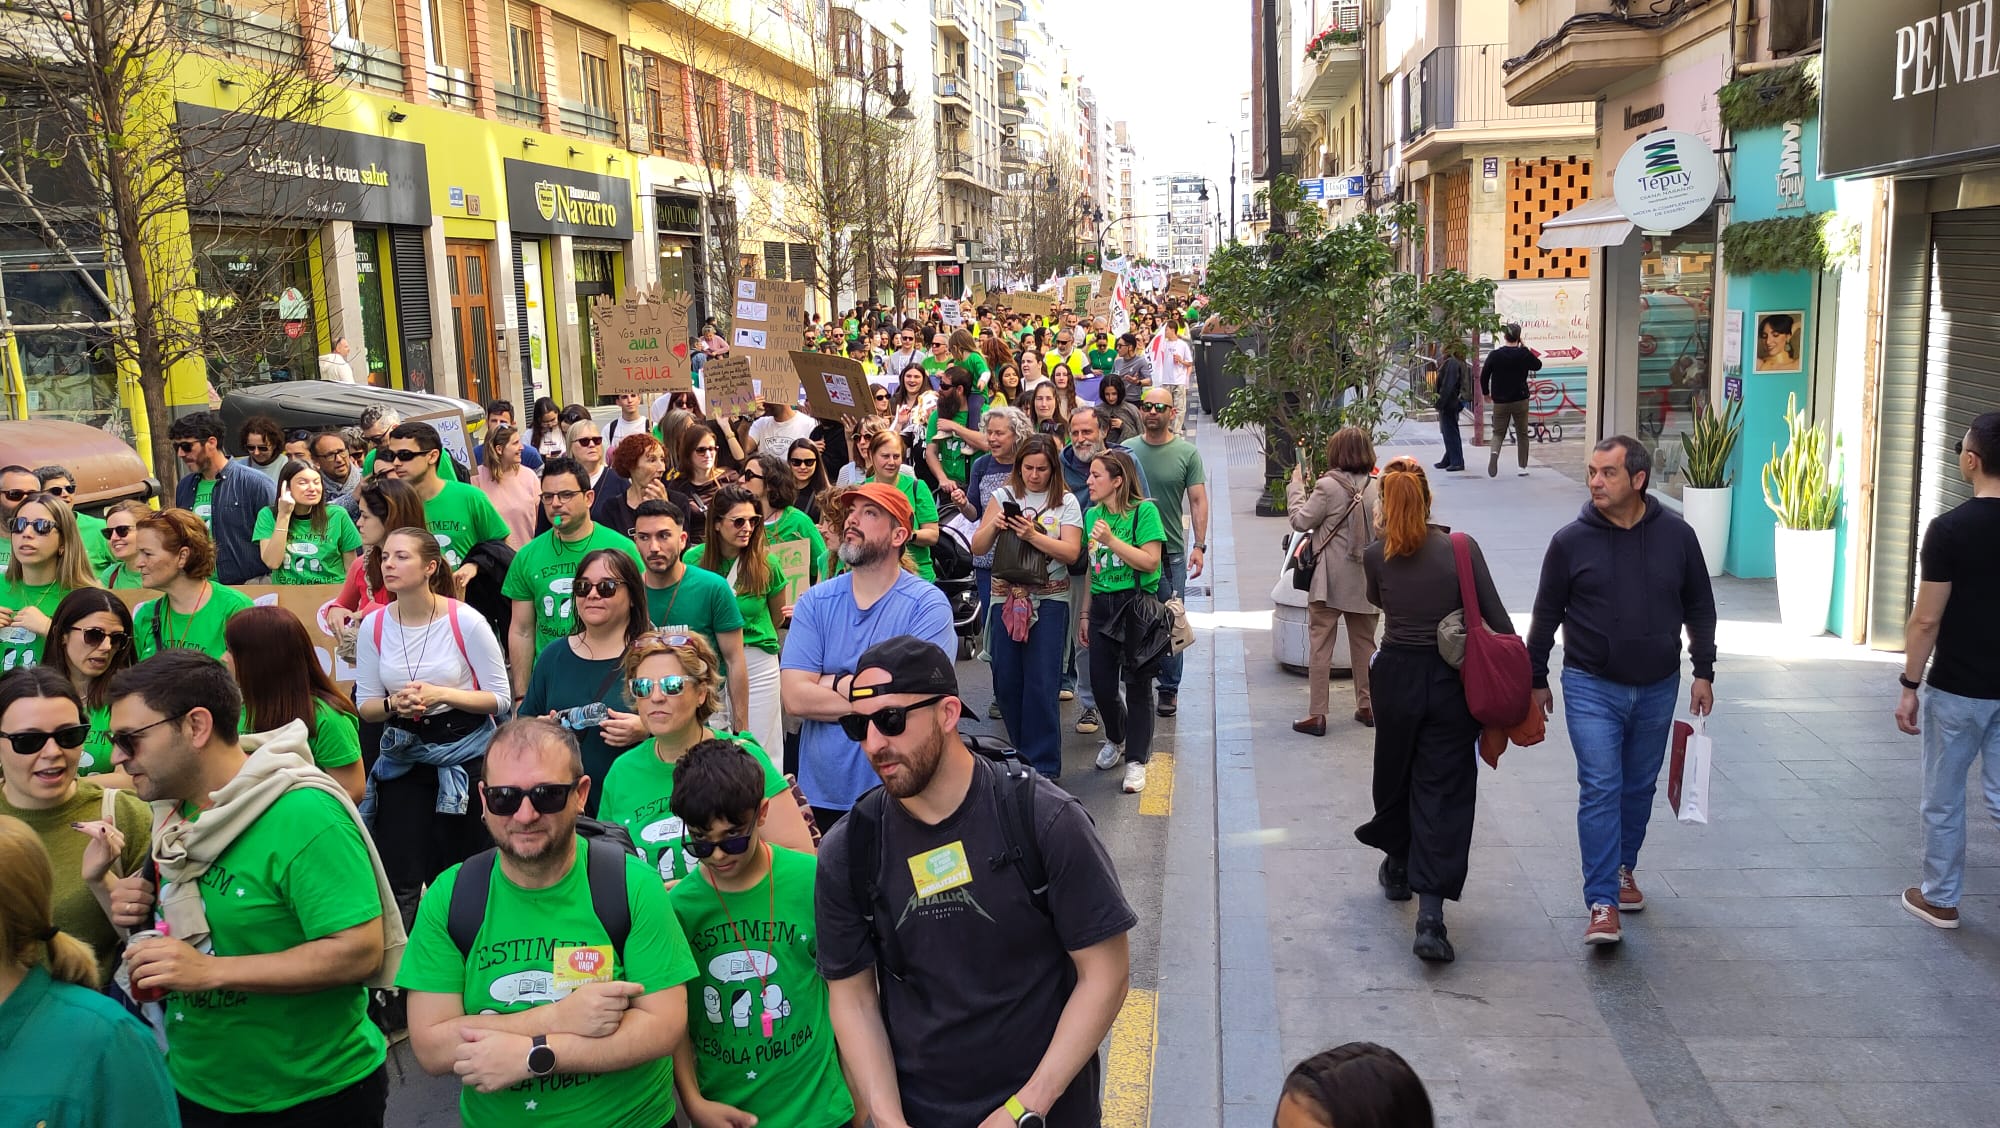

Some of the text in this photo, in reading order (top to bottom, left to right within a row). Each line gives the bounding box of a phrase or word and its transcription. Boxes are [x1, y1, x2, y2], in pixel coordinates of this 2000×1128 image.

[1892, 0, 2000, 100] PENH
[304, 154, 320, 179] de
[321, 156, 334, 181] la
[335, 166, 360, 183] teua
[360, 163, 389, 186] salut
[555, 184, 617, 227] Navarro
[691, 919, 797, 953] ESTIMEM
[477, 937, 597, 971] ESTIM
[574, 951, 584, 961] JO
[756, 1024, 813, 1065] PÚBLICA
